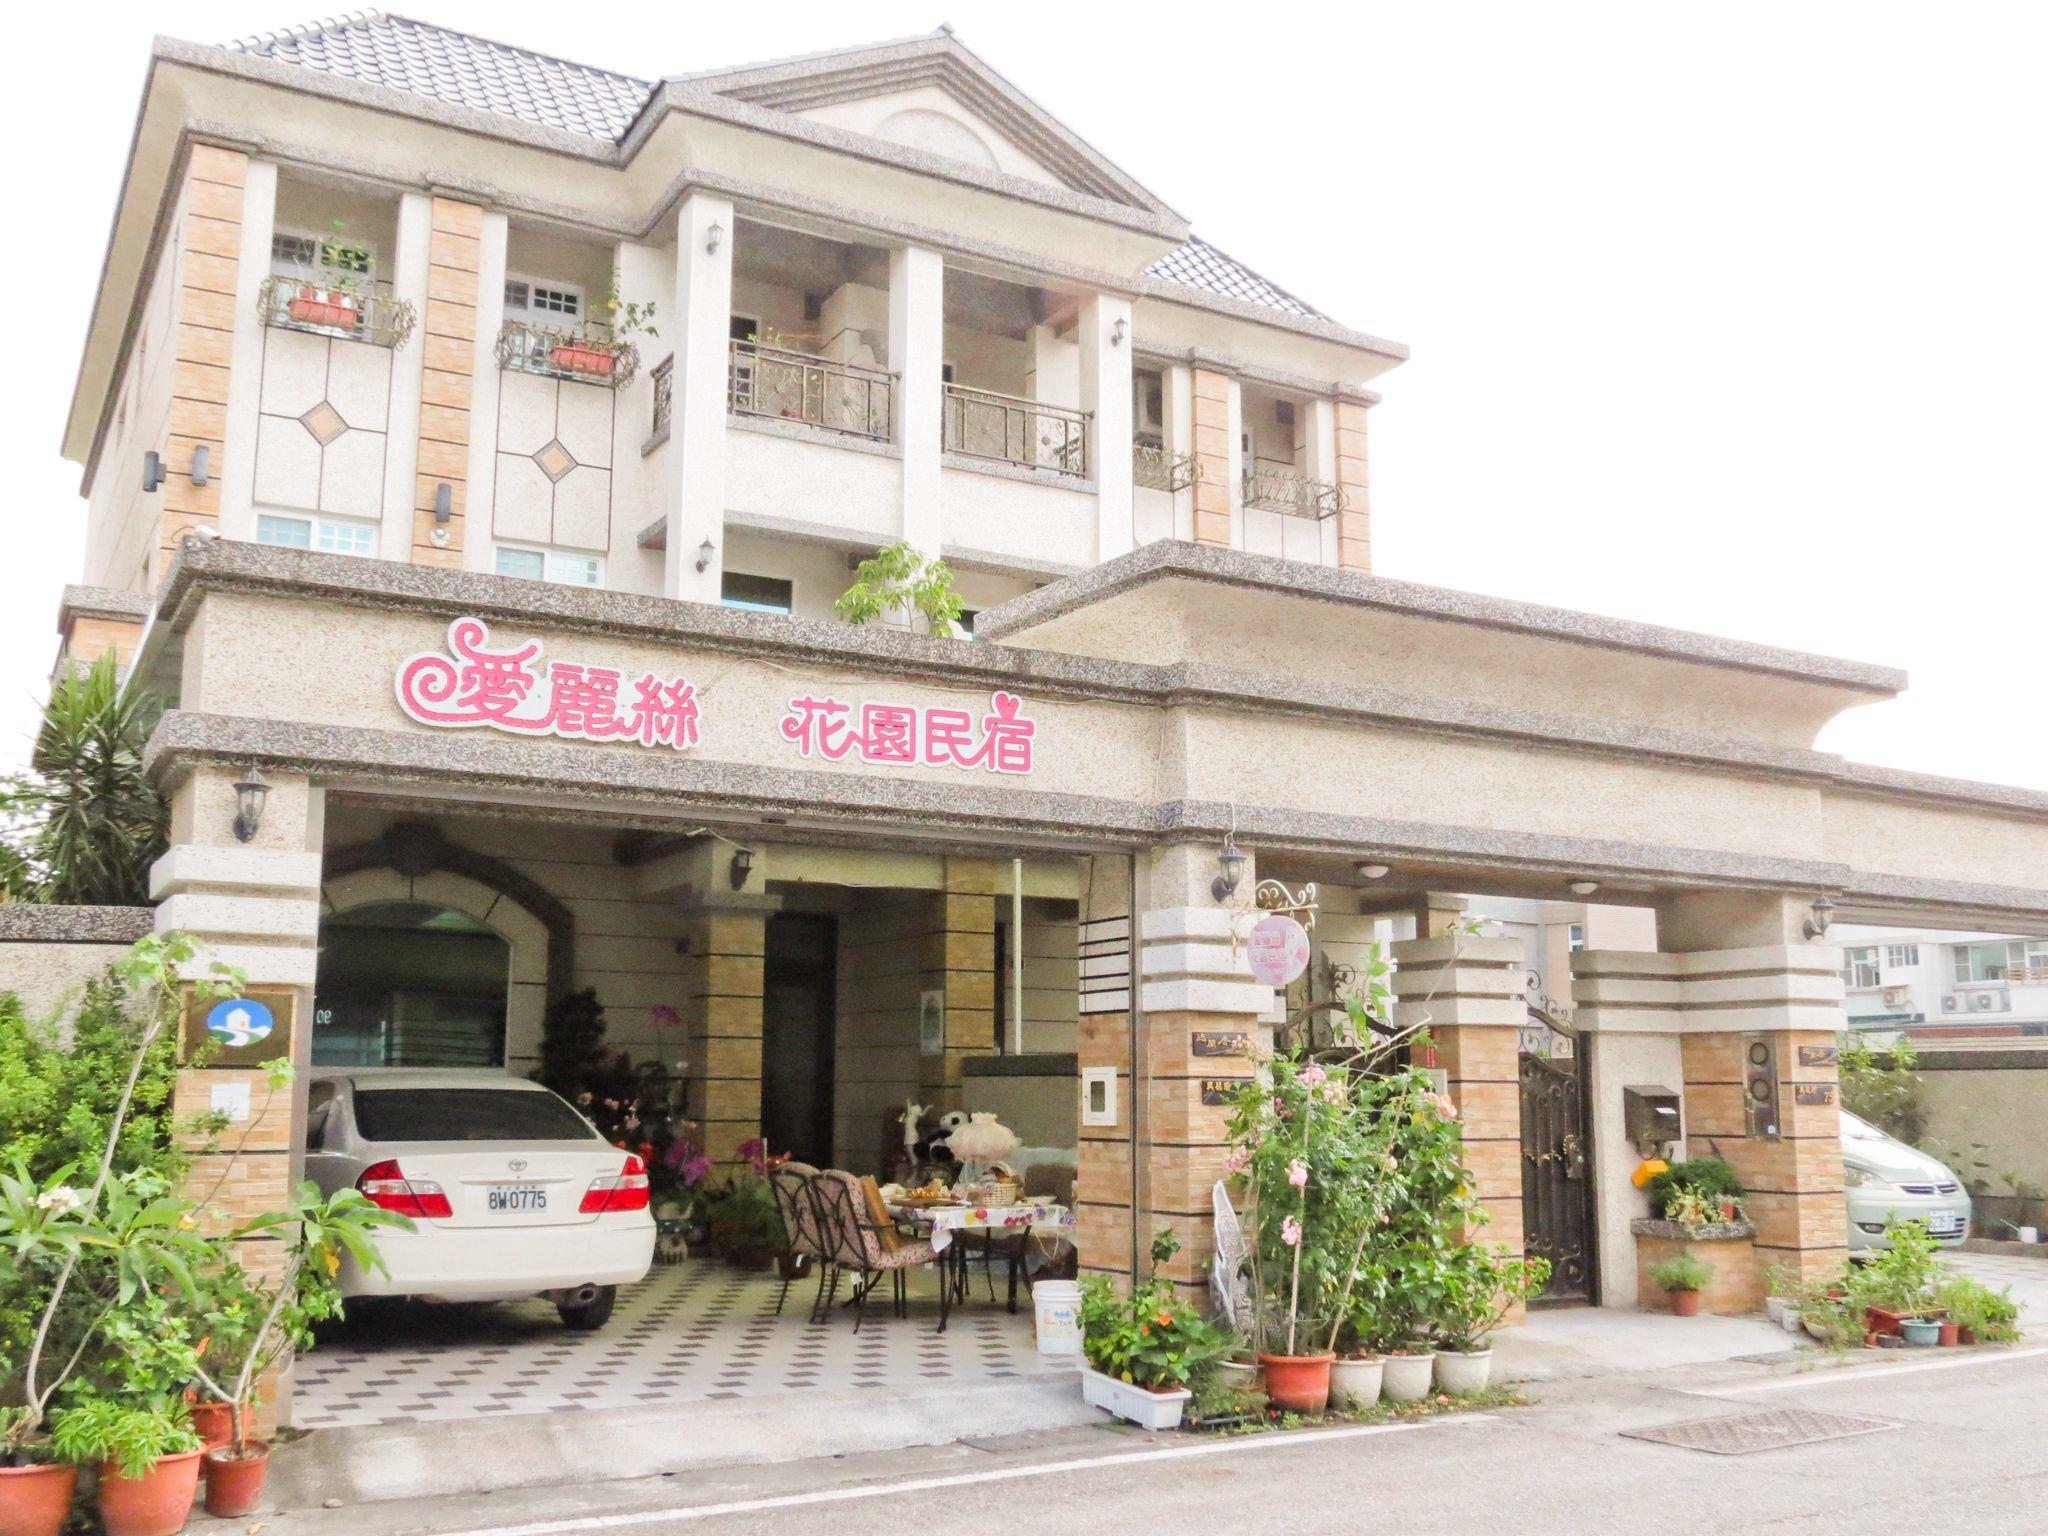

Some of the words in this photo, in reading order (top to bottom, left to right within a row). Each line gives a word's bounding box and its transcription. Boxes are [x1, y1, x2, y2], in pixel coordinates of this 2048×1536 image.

[401, 620, 699, 749] 愛麗絲
[783, 692, 1034, 772] 花園民宿
[489, 1190, 547, 1210] 8W-0775
